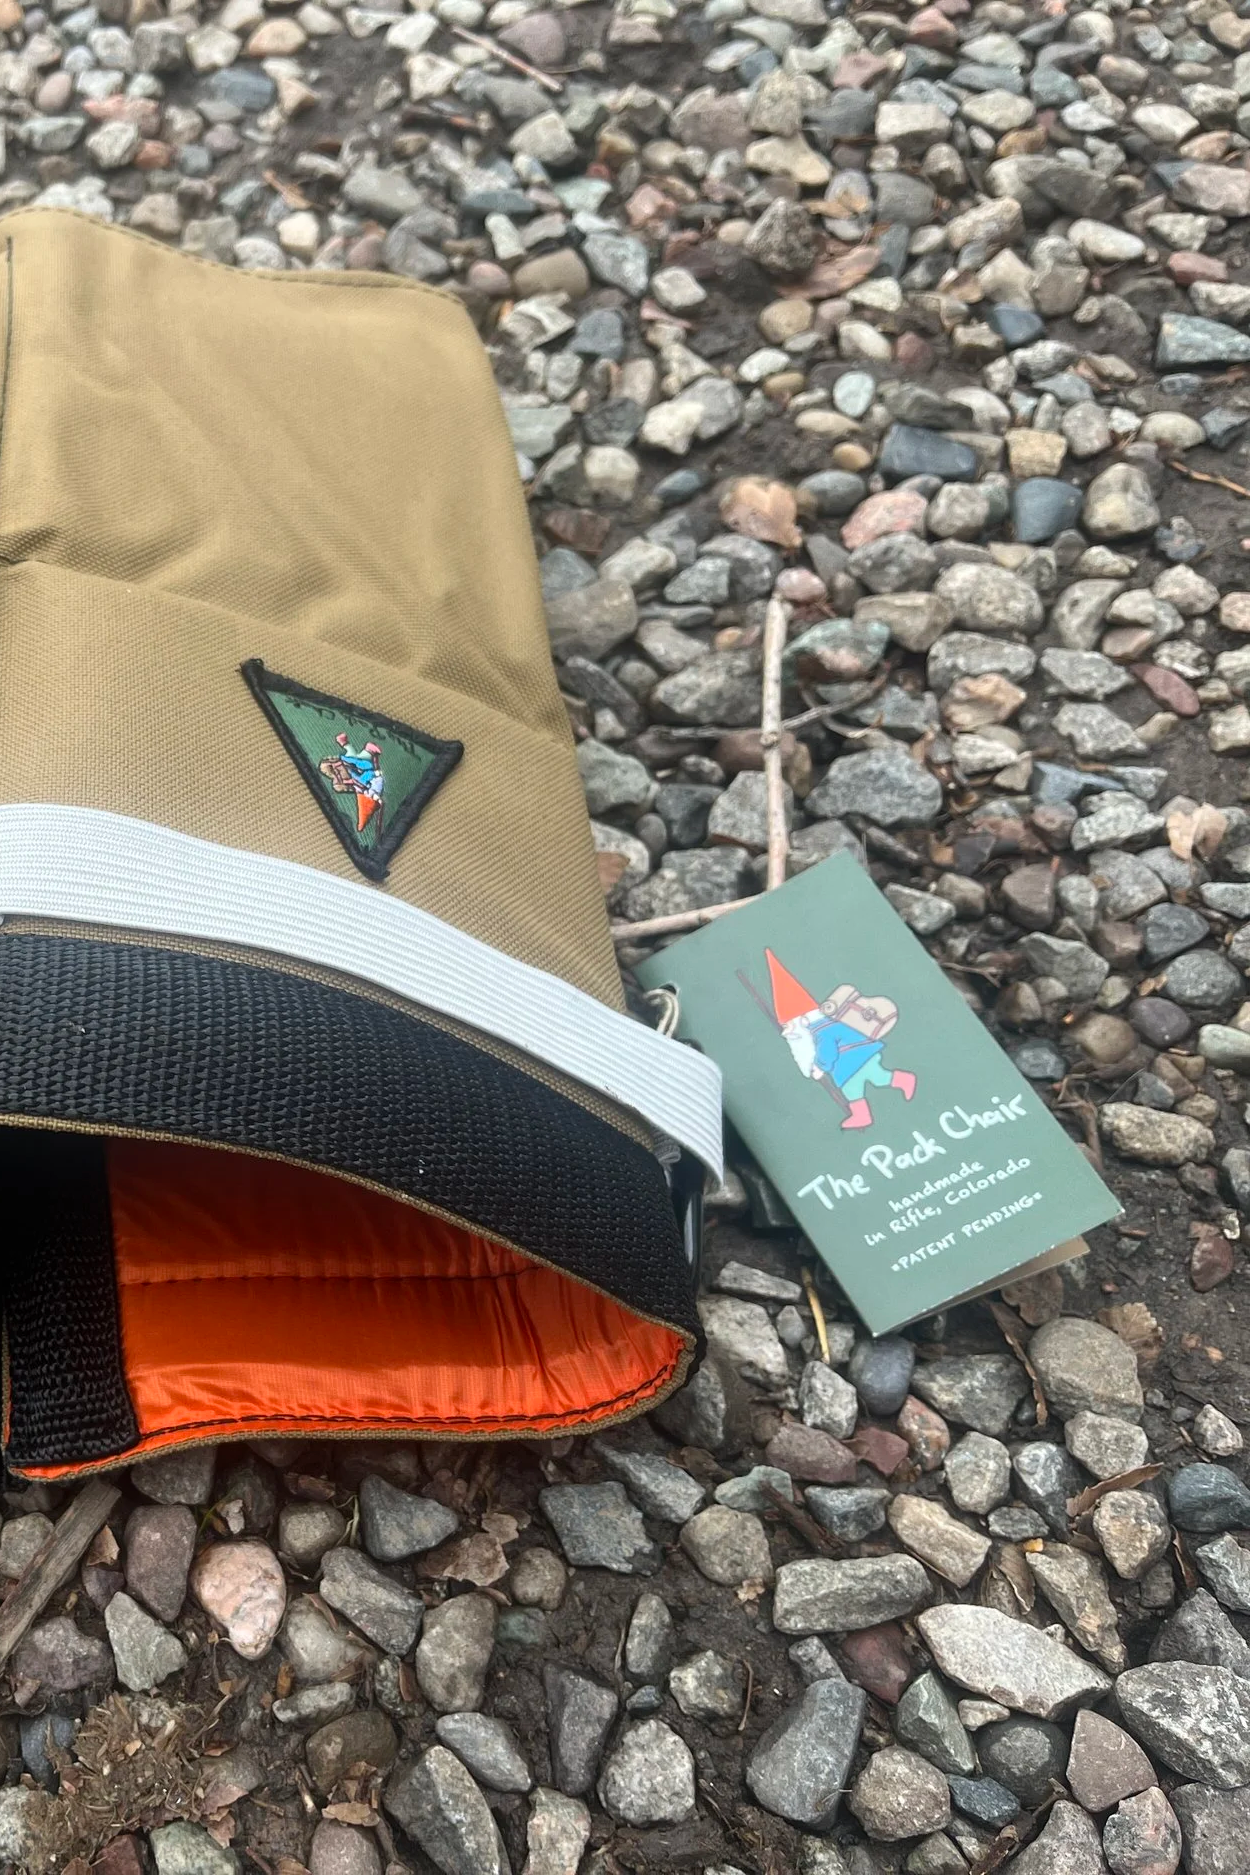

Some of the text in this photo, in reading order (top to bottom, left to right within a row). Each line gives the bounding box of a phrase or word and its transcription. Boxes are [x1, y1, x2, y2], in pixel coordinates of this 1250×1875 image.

[797, 1093, 1027, 1210] The Pack Chair
[888, 1161, 984, 1213] handmade
[864, 1157, 1031, 1246] in Rifle, Colorado
